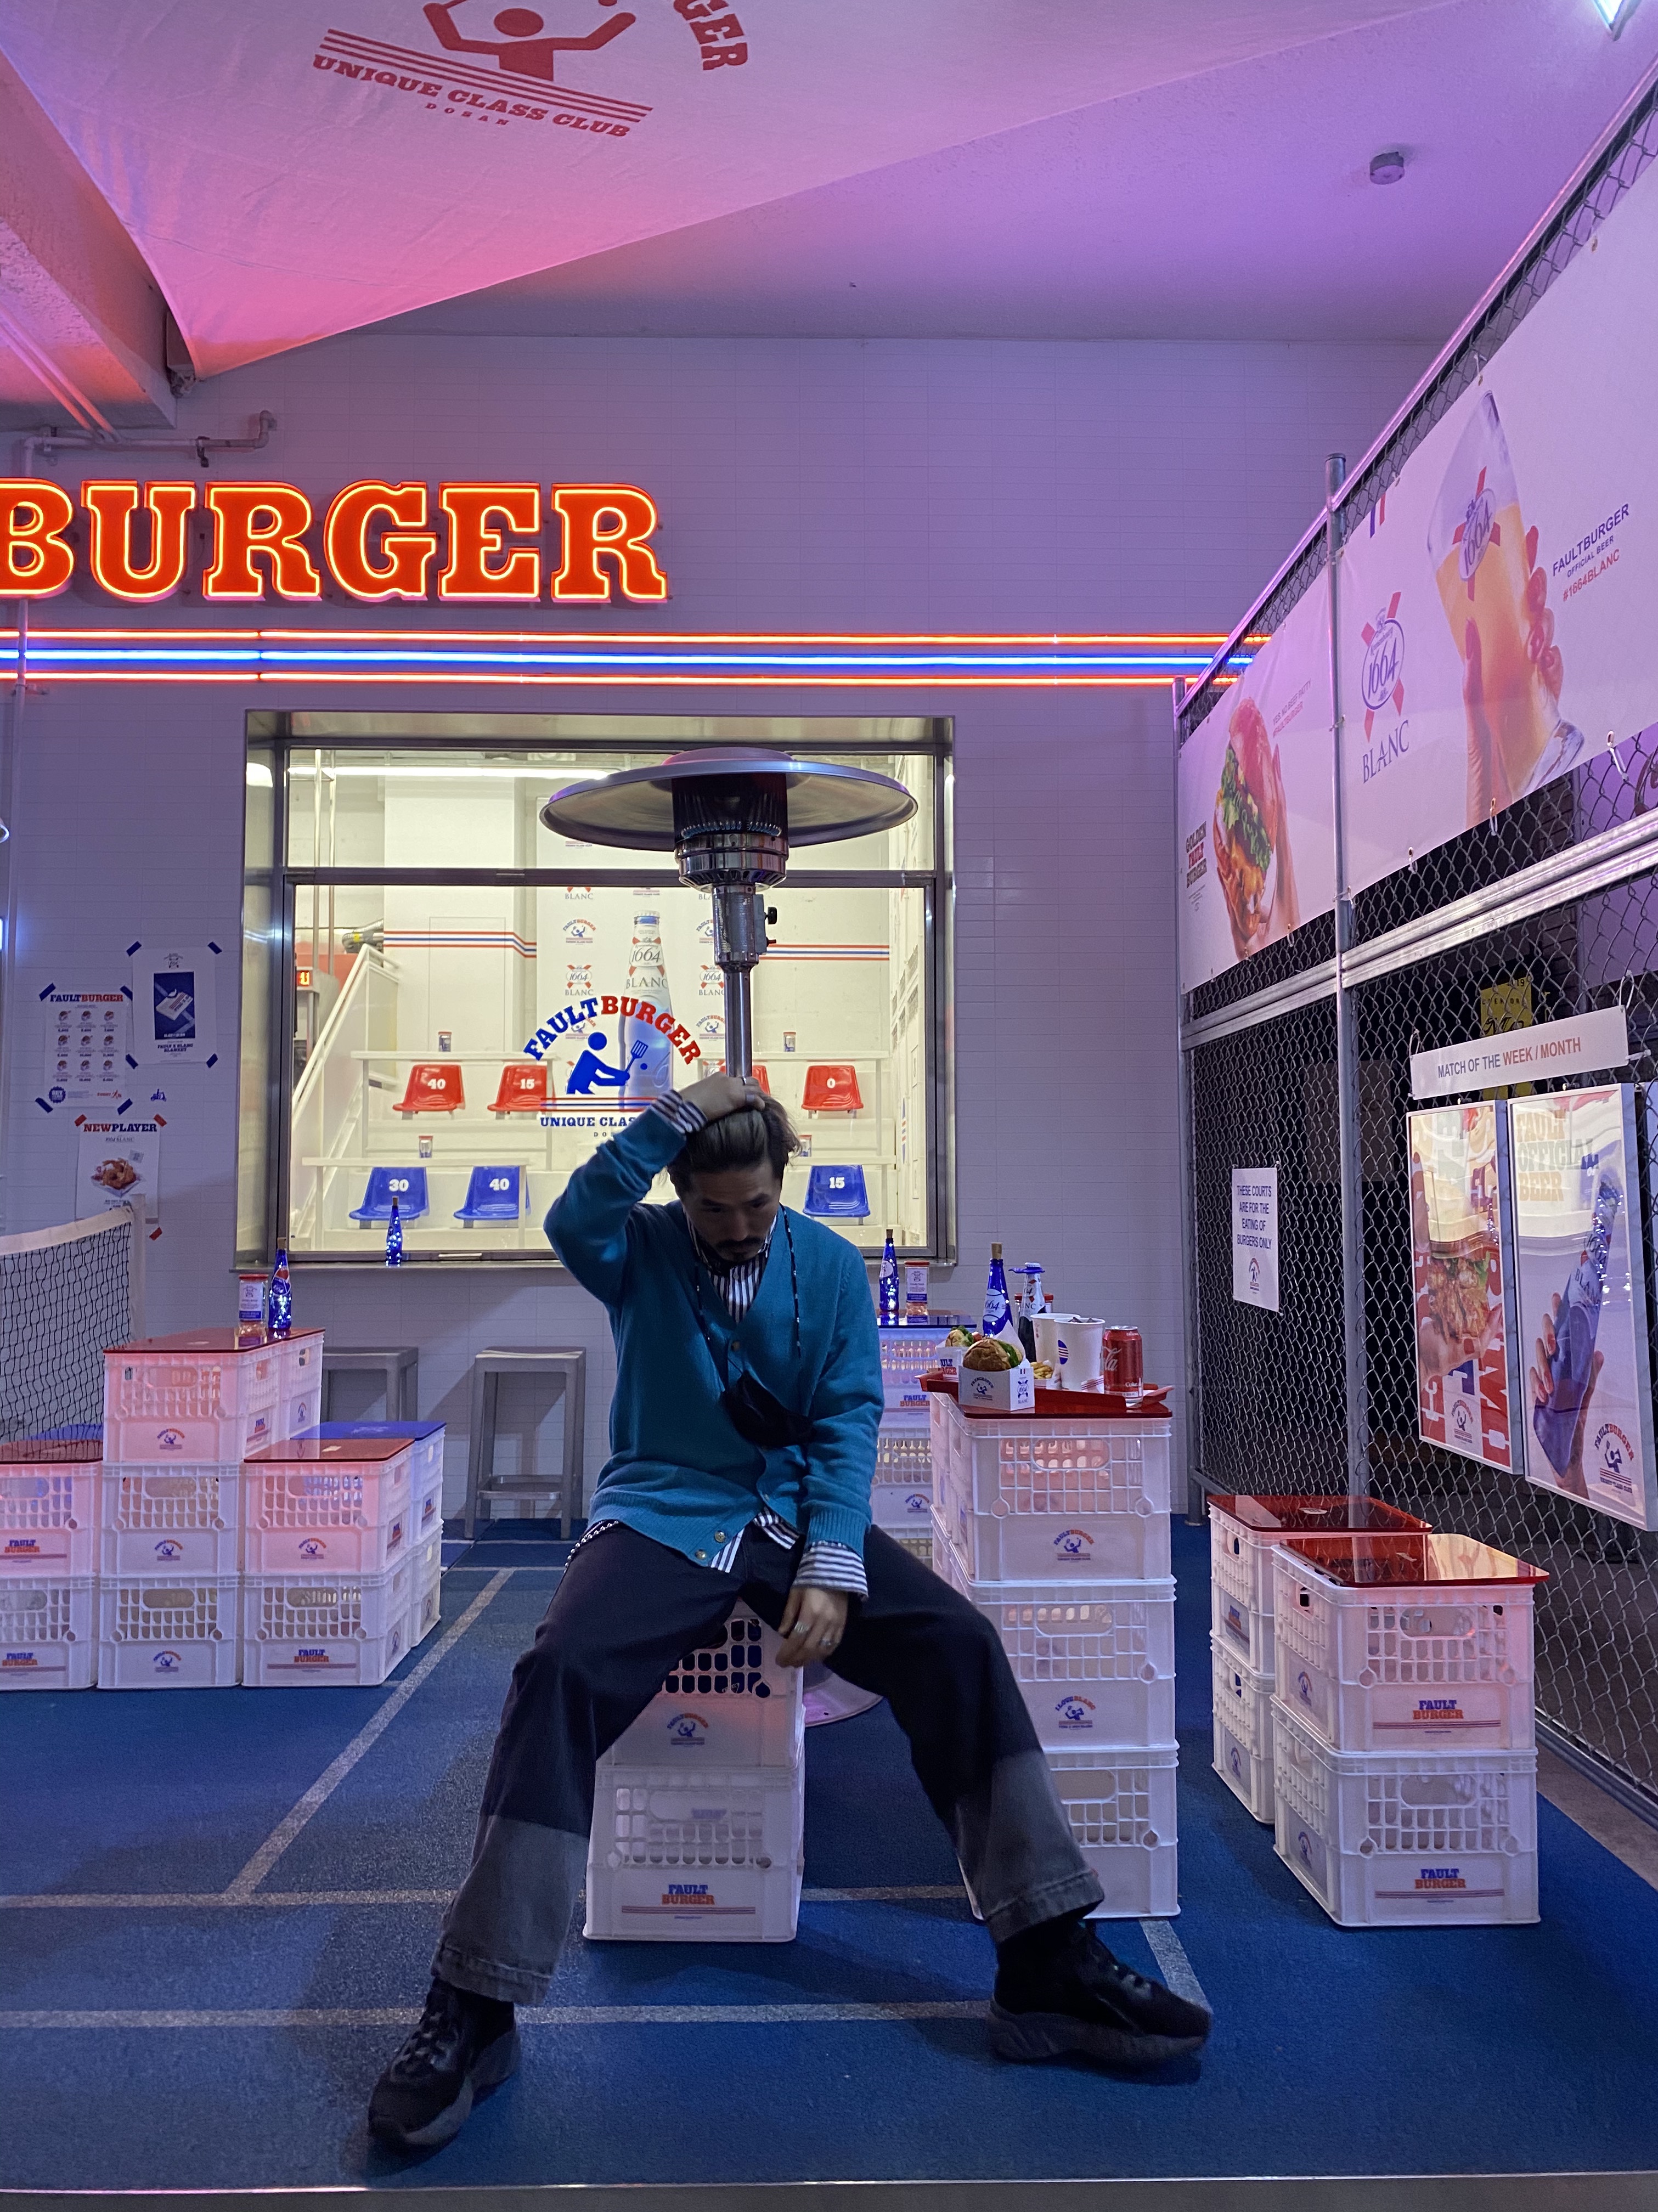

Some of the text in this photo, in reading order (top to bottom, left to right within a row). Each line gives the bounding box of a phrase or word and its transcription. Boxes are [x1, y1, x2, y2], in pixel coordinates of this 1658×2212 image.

[313, 54, 630, 138] UNIQUE CLASS CLUB
[0, 477, 668, 603] BURGER
[1553, 503, 1629, 577] FAULTBURGER
[1567, 535, 1614, 578] OFFICIAL BEER
[1563, 549, 1620, 602] #1664BLANC
[1368, 636, 1399, 700] 1664
[1362, 719, 1409, 785] BLANC
[1186, 820, 1206, 854] GOLDEN
[631, 947, 661, 963] 1664
[569, 972, 588, 981] 1664
[625, 977, 669, 989] BLANC
[50, 994, 123, 1002] FAULTBURGER
[523, 996, 701, 1065] FAULTBURGER
[1437, 1060, 1466, 1078] MATCH
[1468, 1058, 1480, 1072] OF
[1481, 1053, 1501, 1070] THE
[1502, 1046, 1533, 1066] WEEK
[1540, 1037, 1581, 1059] MONTH
[427, 1078, 446, 1090] 40
[520, 1078, 535, 1090] 15
[827, 1077, 836, 1089] 0
[83, 1124, 157, 1132] NEWPLAYER
[540, 1117, 636, 1127] UNIQUE CLAS
[1516, 1111, 1565, 1143] FAULT
[1518, 1138, 1599, 1172] OFFICIAL
[389, 1179, 409, 1192] 30
[489, 1178, 510, 1191] 40
[829, 1177, 845, 1189] 15
[1519, 1171, 1565, 1201] BEER
[1237, 1185, 1272, 1197] THESE COURTS
[1239, 1201, 1269, 1214] ARE FOR THE
[1242, 1218, 1266, 1231] EATING OF
[1237, 1234, 1272, 1250] BURGERS ONLY
[1594, 1423, 1634, 1462] FAULTBURGER
[1418, 1699, 1457, 1710] FAULT
[1413, 1709, 1464, 1720] BURGER
[1420, 1868, 1459, 1879] FAULT
[668, 1883, 708, 1895] FAULT
[1414, 1878, 1467, 1889] BURGER
[662, 1894, 715, 1905] BURGER
